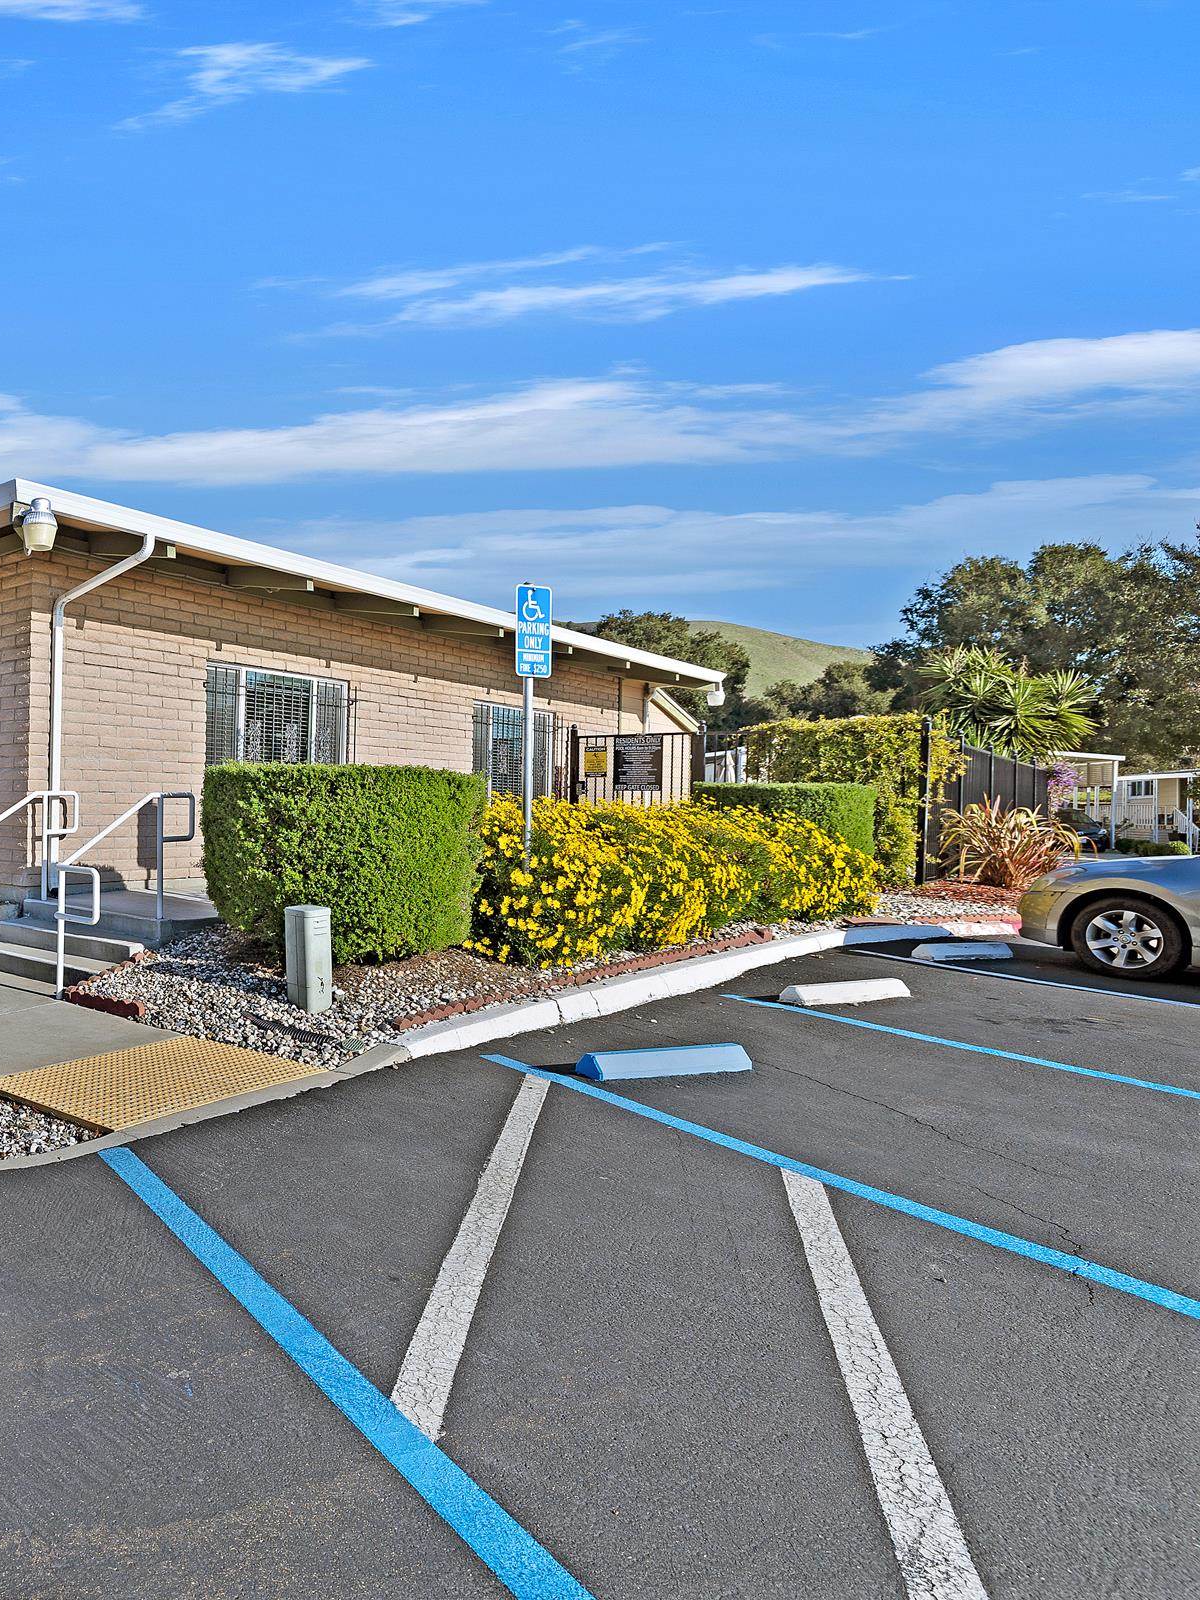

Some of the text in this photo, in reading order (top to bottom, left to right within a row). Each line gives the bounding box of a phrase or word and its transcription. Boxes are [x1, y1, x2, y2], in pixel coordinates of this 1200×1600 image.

[519, 621, 549, 635] PARKING
[524, 635, 543, 649] ONLY
[533, 663, 547, 673] $250
